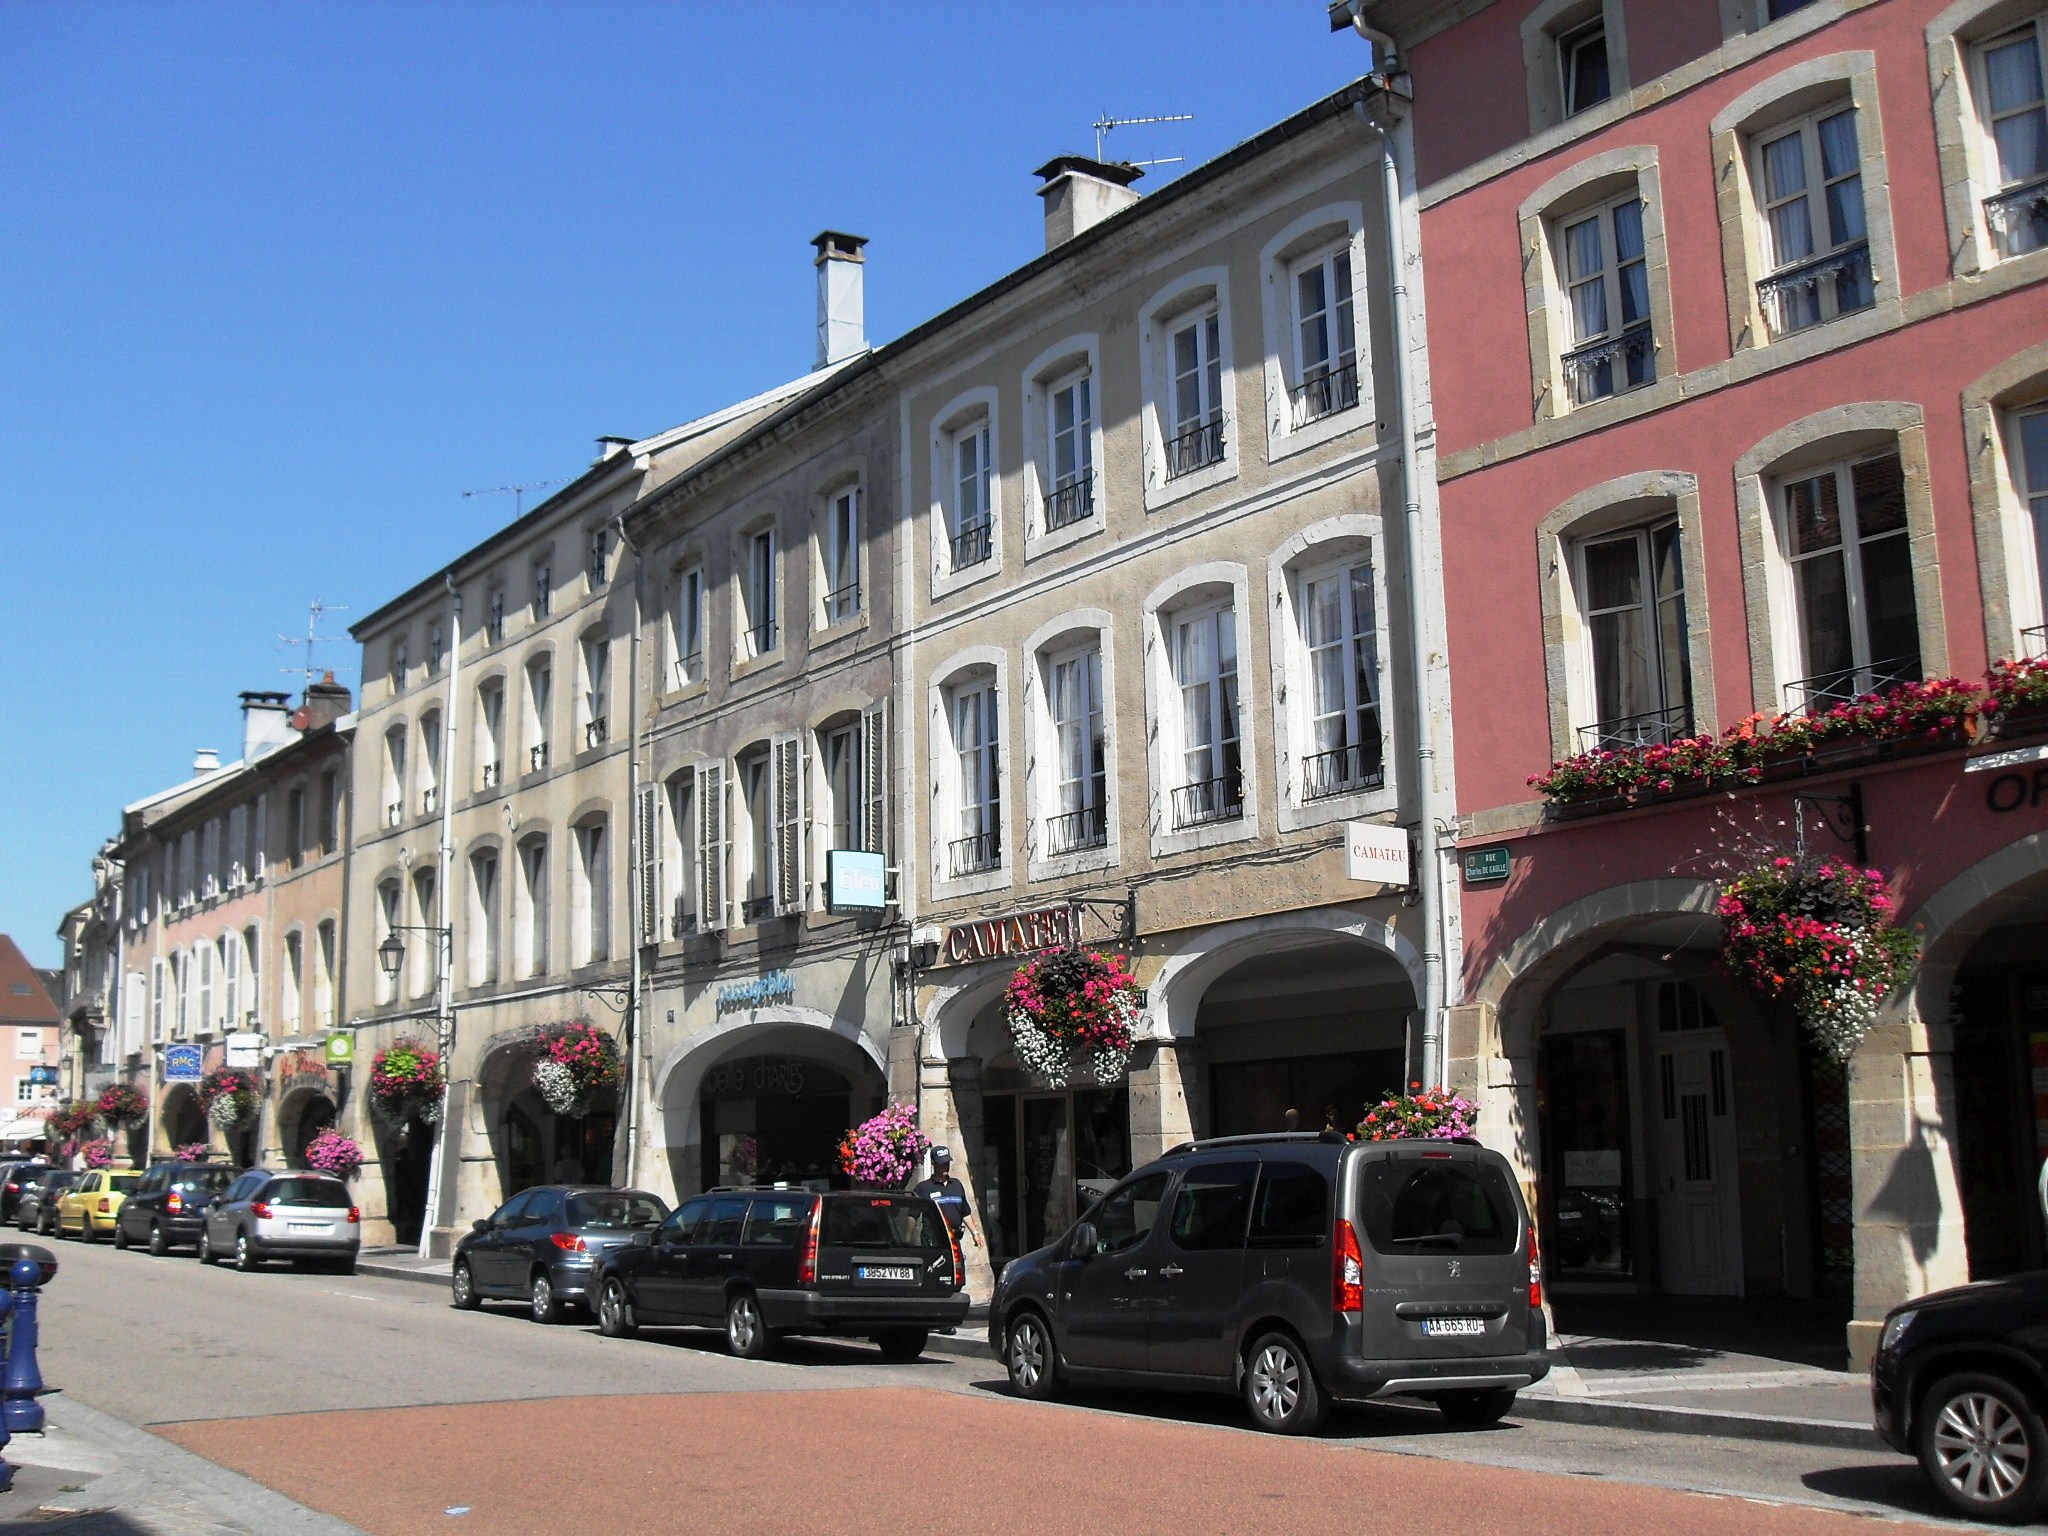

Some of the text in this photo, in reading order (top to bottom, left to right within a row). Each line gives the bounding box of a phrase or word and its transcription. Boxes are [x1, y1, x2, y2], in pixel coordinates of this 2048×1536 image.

[1485, 853, 1497, 862] RUE
[718, 968, 796, 1011] passagebleu
[172, 1055, 195, 1067] RMC
